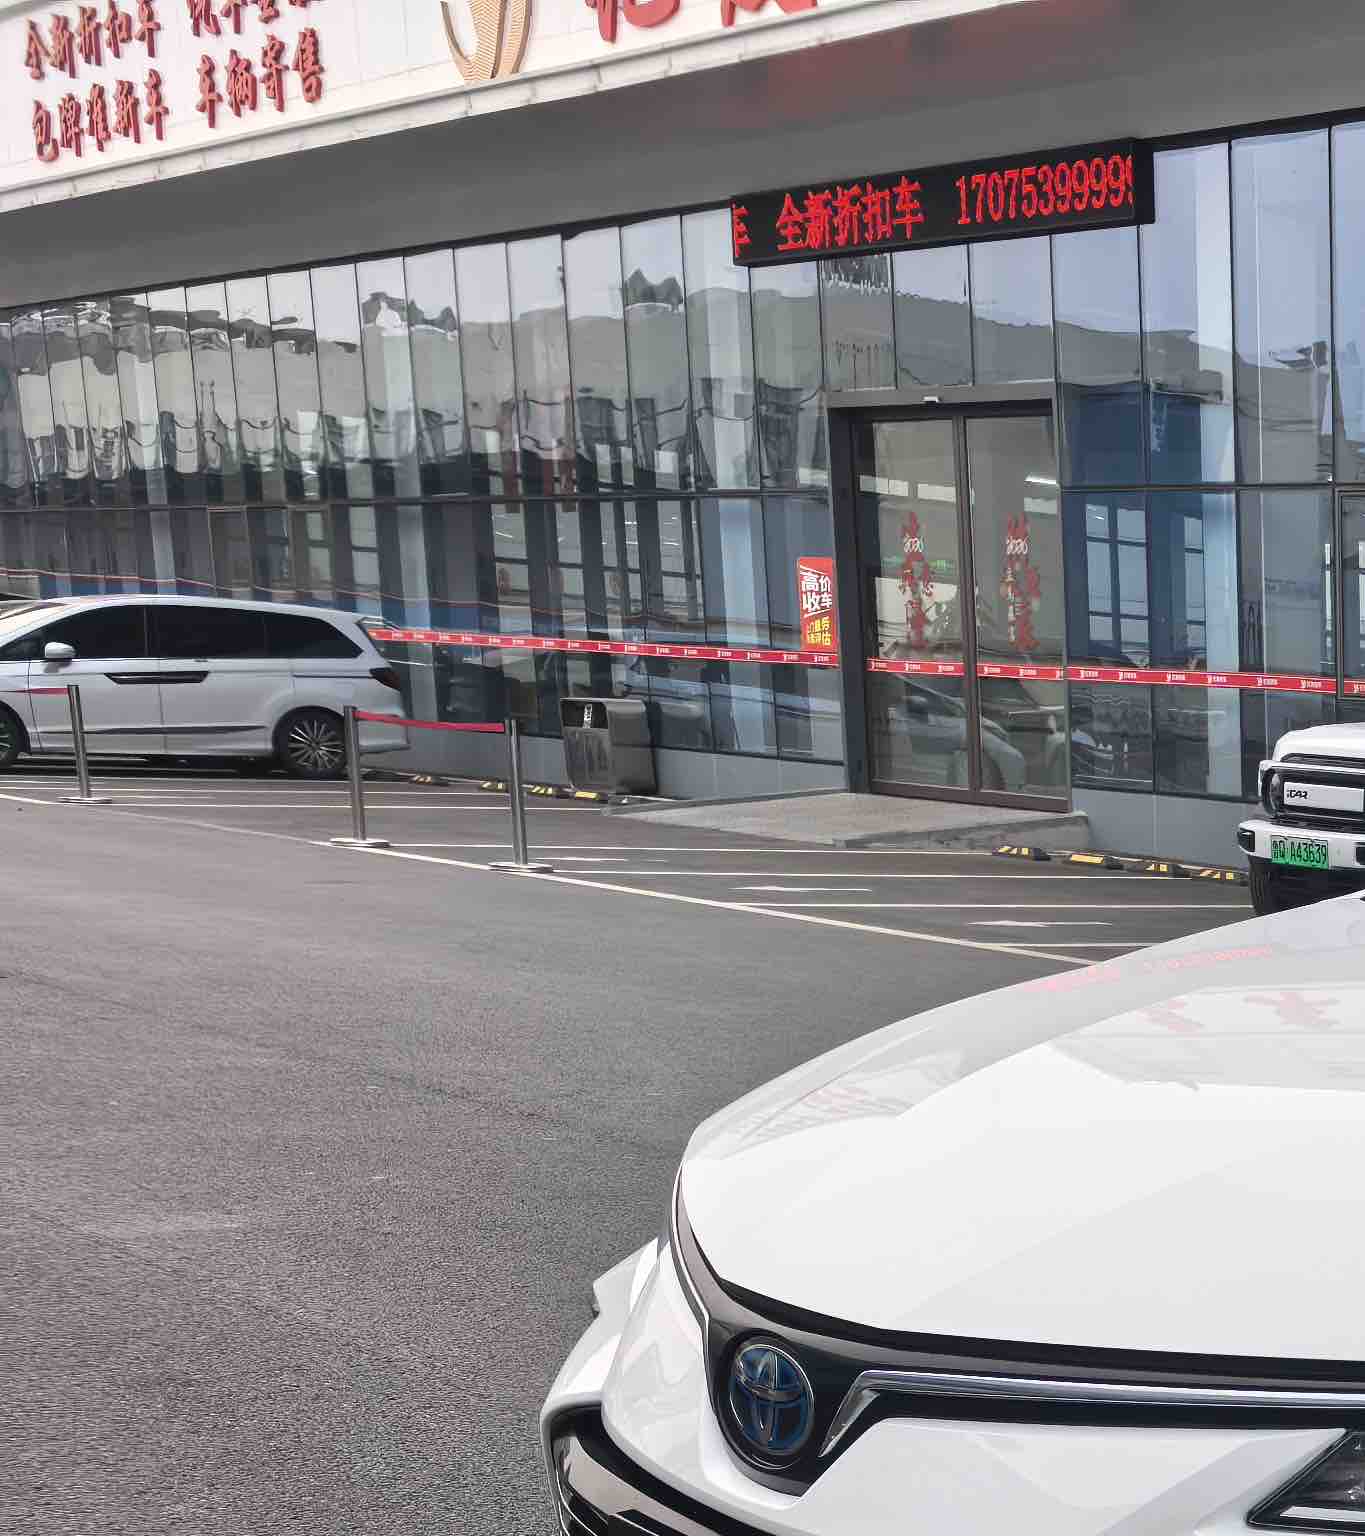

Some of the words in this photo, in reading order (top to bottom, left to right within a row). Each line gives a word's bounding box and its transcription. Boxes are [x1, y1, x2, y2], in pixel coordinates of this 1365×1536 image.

[775, 176, 926, 252] 全新折扣车
[801, 574, 832, 593] 高价
[802, 592, 833, 613] 收车
